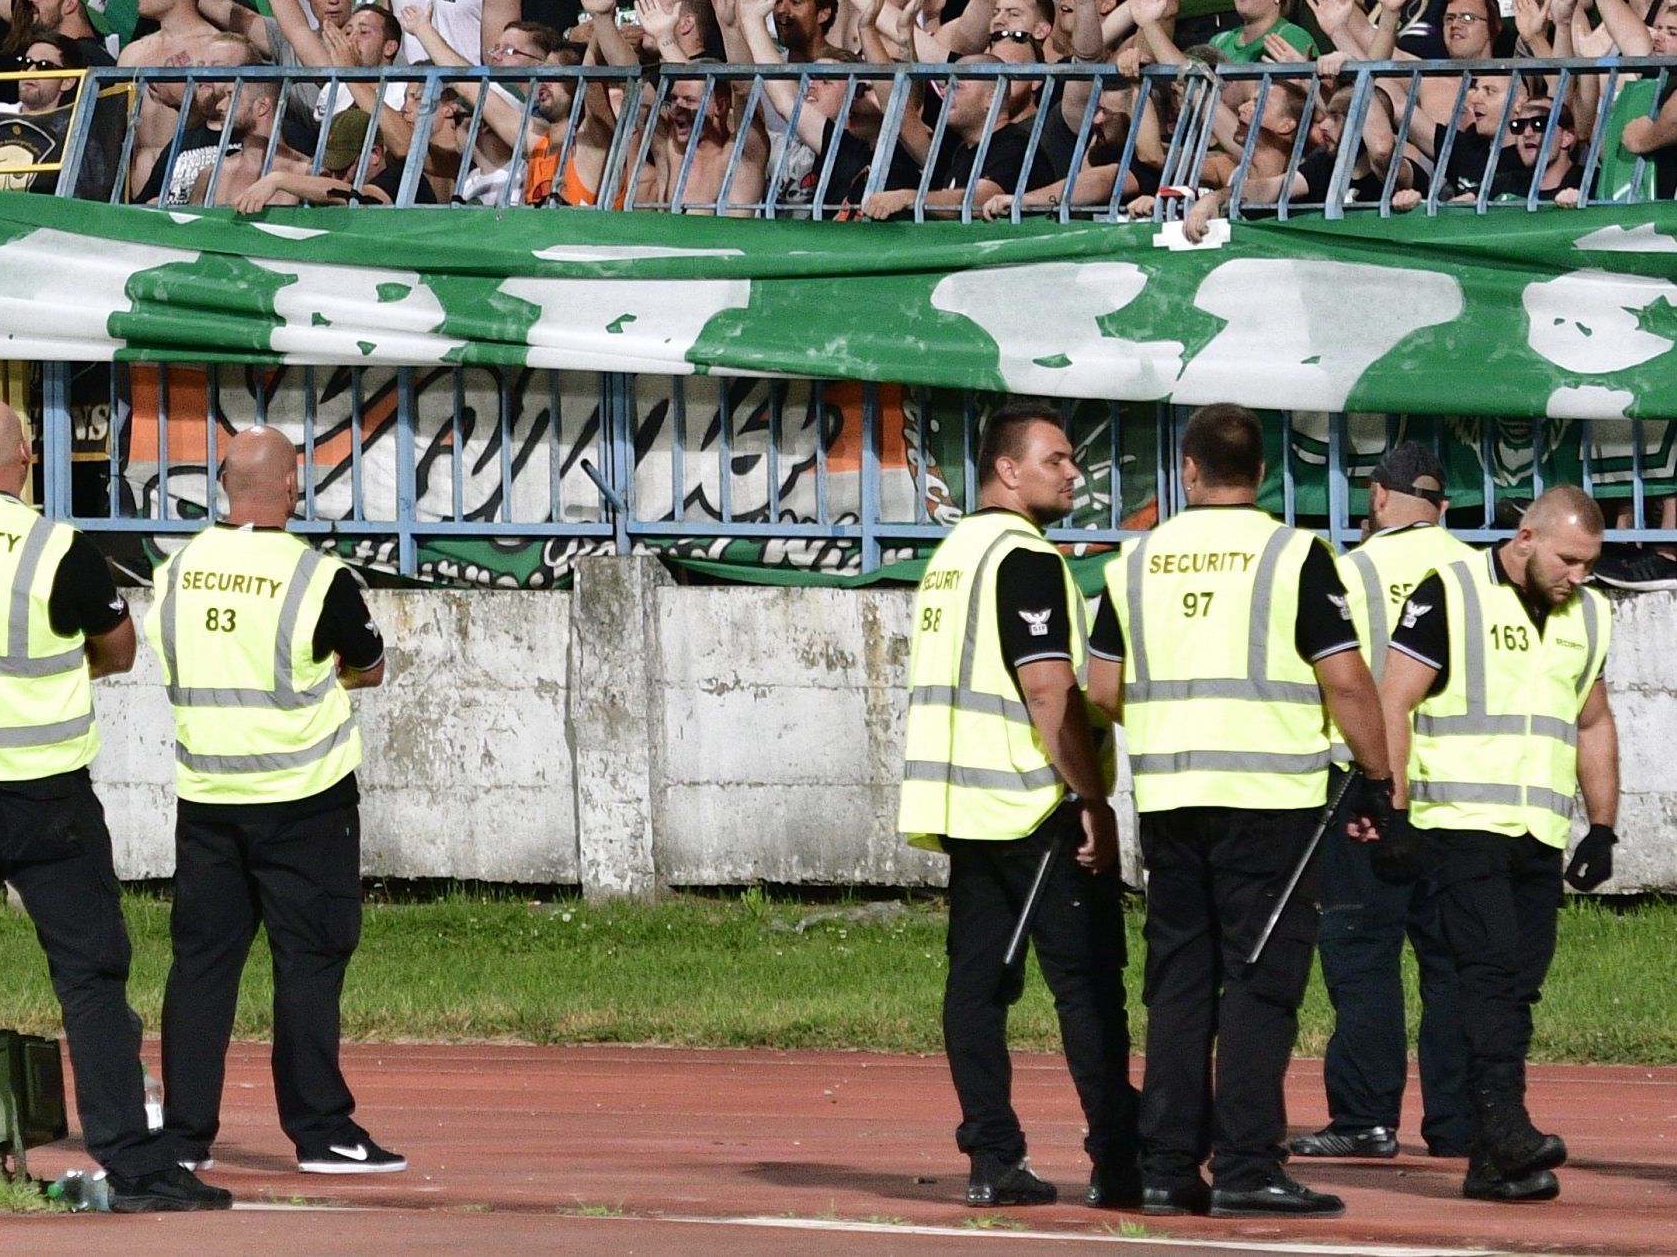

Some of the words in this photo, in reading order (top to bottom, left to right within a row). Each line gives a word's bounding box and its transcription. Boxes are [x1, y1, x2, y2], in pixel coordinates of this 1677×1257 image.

[1149, 552, 1256, 574] SECURITY
[182, 571, 283, 598] SECURITY
[1183, 591, 1214, 618] 97
[205, 607, 236, 632] 83
[1489, 624, 1529, 651] 163
